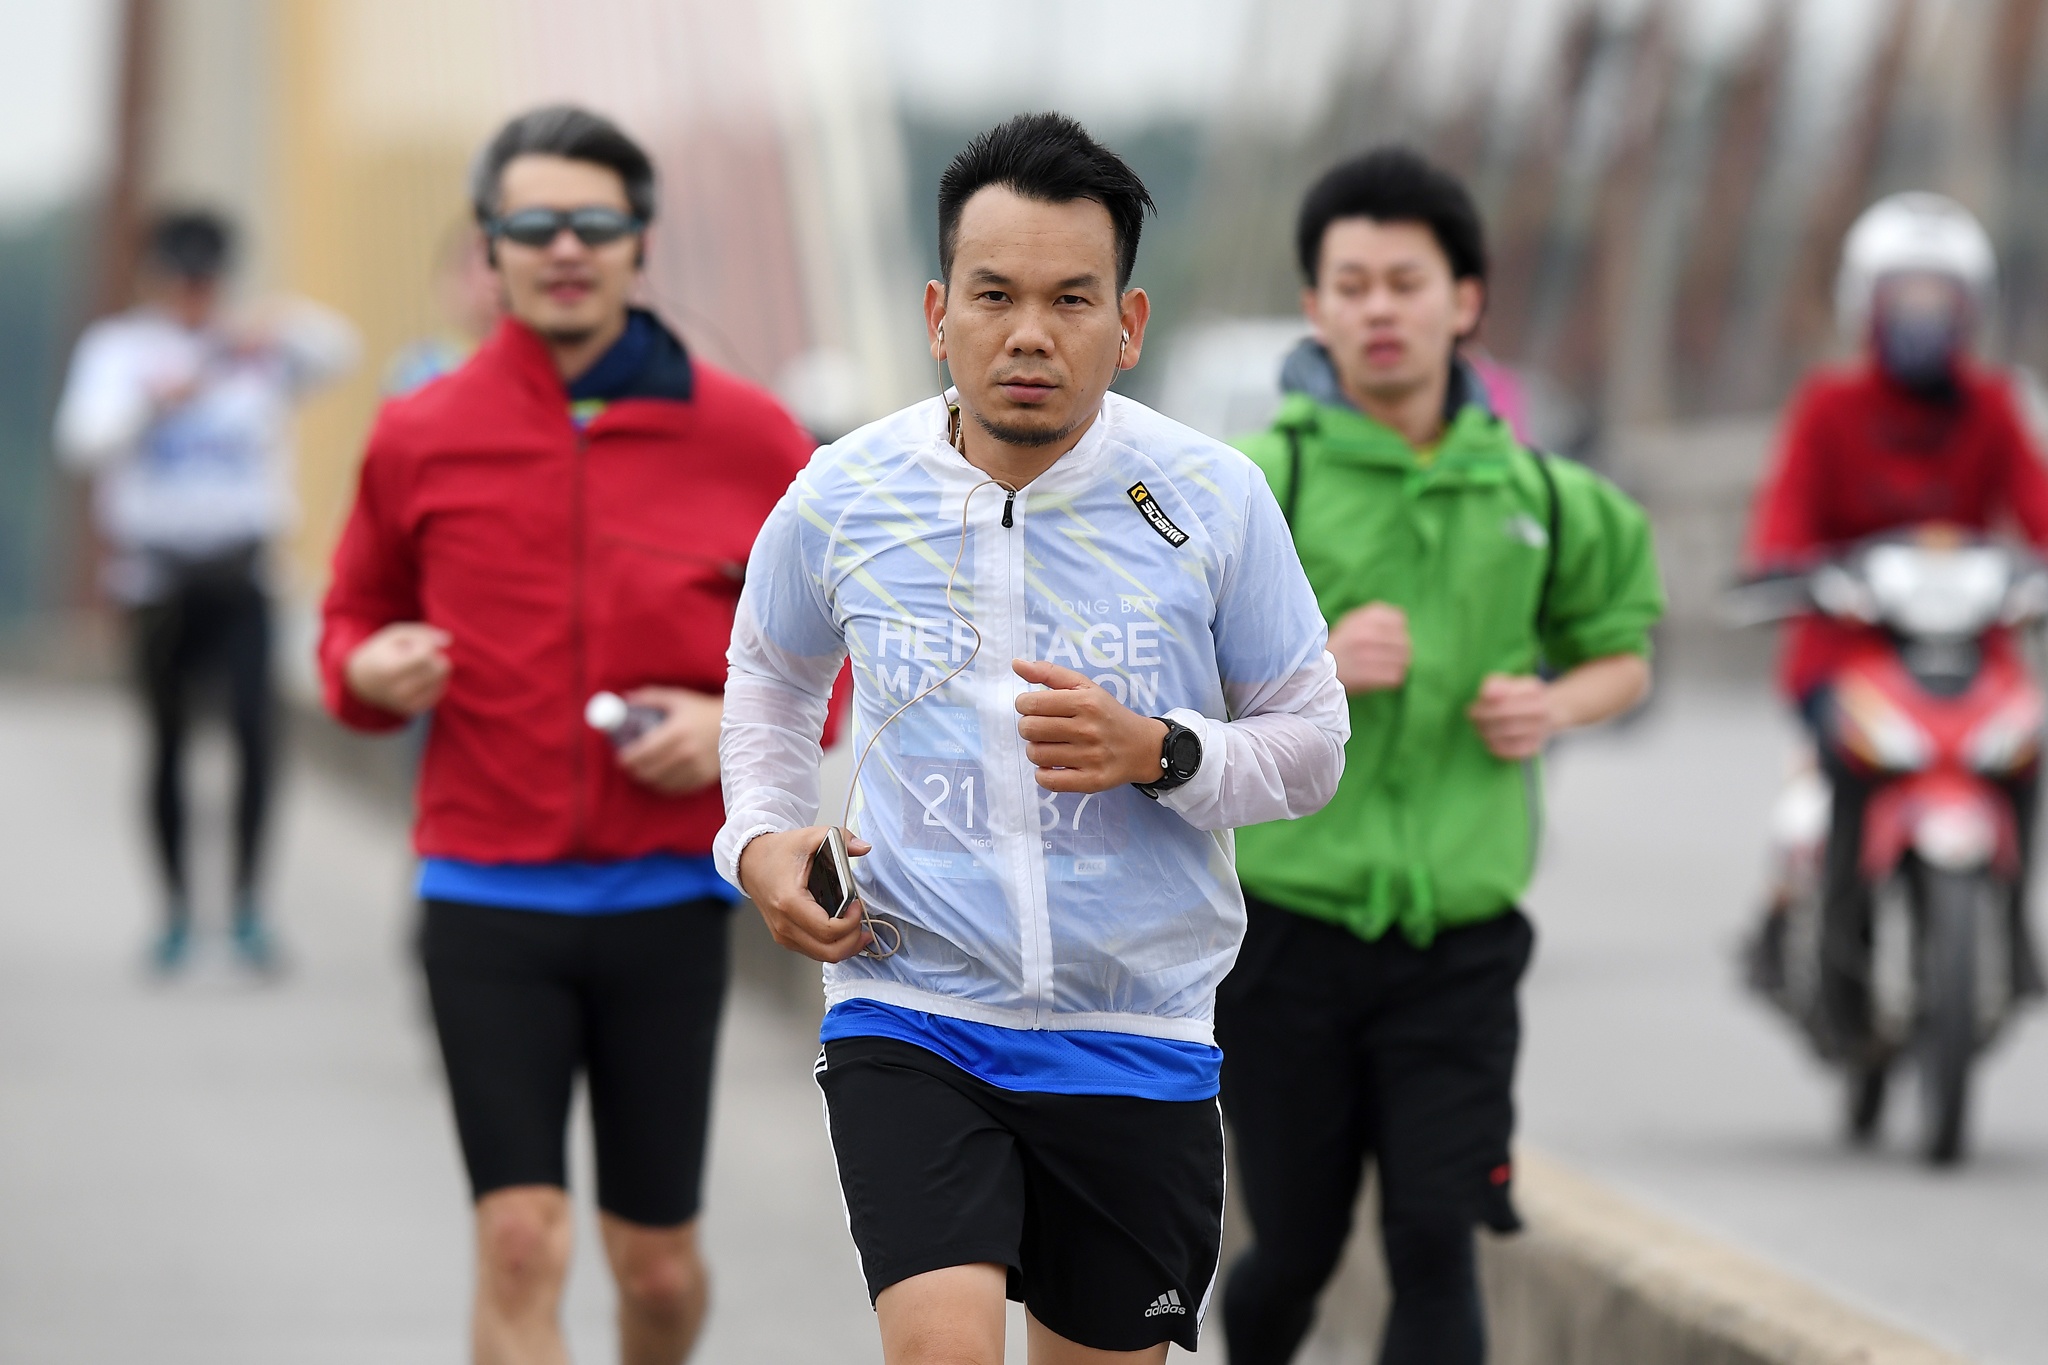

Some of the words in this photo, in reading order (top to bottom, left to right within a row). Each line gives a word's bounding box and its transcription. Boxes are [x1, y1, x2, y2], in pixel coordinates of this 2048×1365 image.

[1025, 598, 1109, 615] ALONG
[1120, 597, 1159, 614] BAY
[877, 617, 1161, 668] HERTAGE
[1144, 1303, 1186, 1318] adidas
